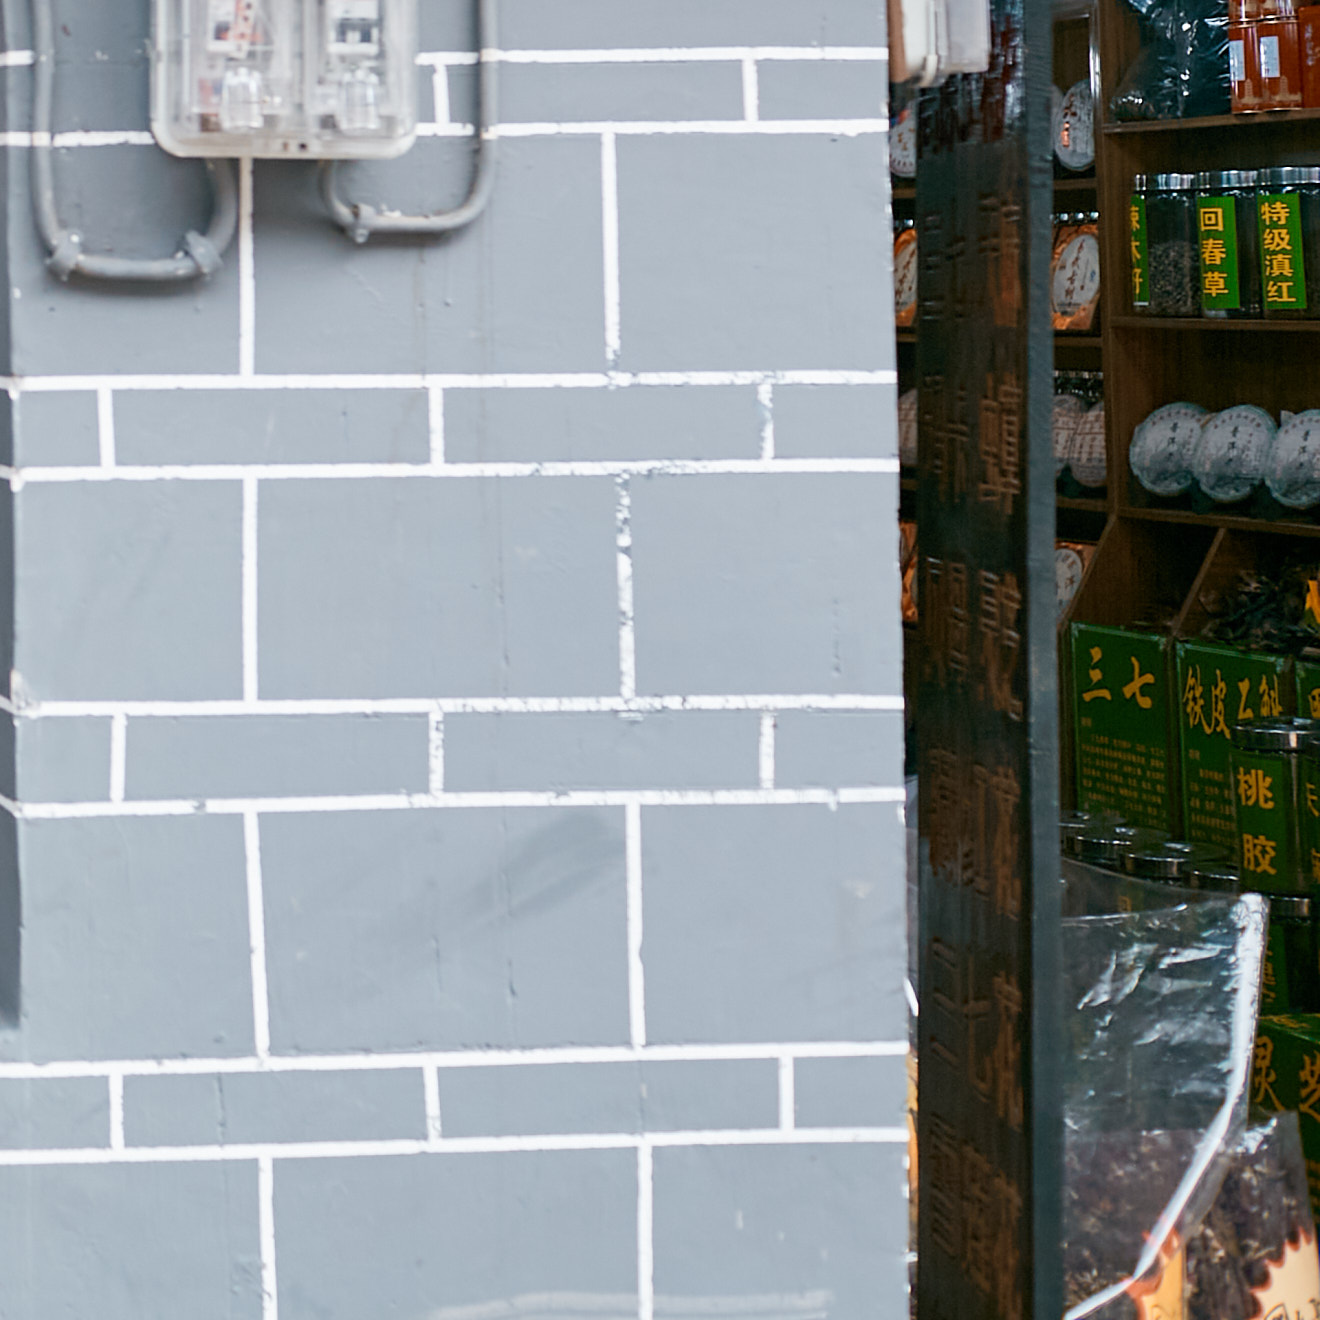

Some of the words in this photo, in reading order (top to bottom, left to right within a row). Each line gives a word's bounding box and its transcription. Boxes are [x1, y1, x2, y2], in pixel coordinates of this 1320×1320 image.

[1199, 207, 1229, 298] 回春草
[1260, 200, 1297, 303] 特级滇红
[1081, 645, 1156, 710] 三七
[1236, 766, 1278, 876] 桃胶
